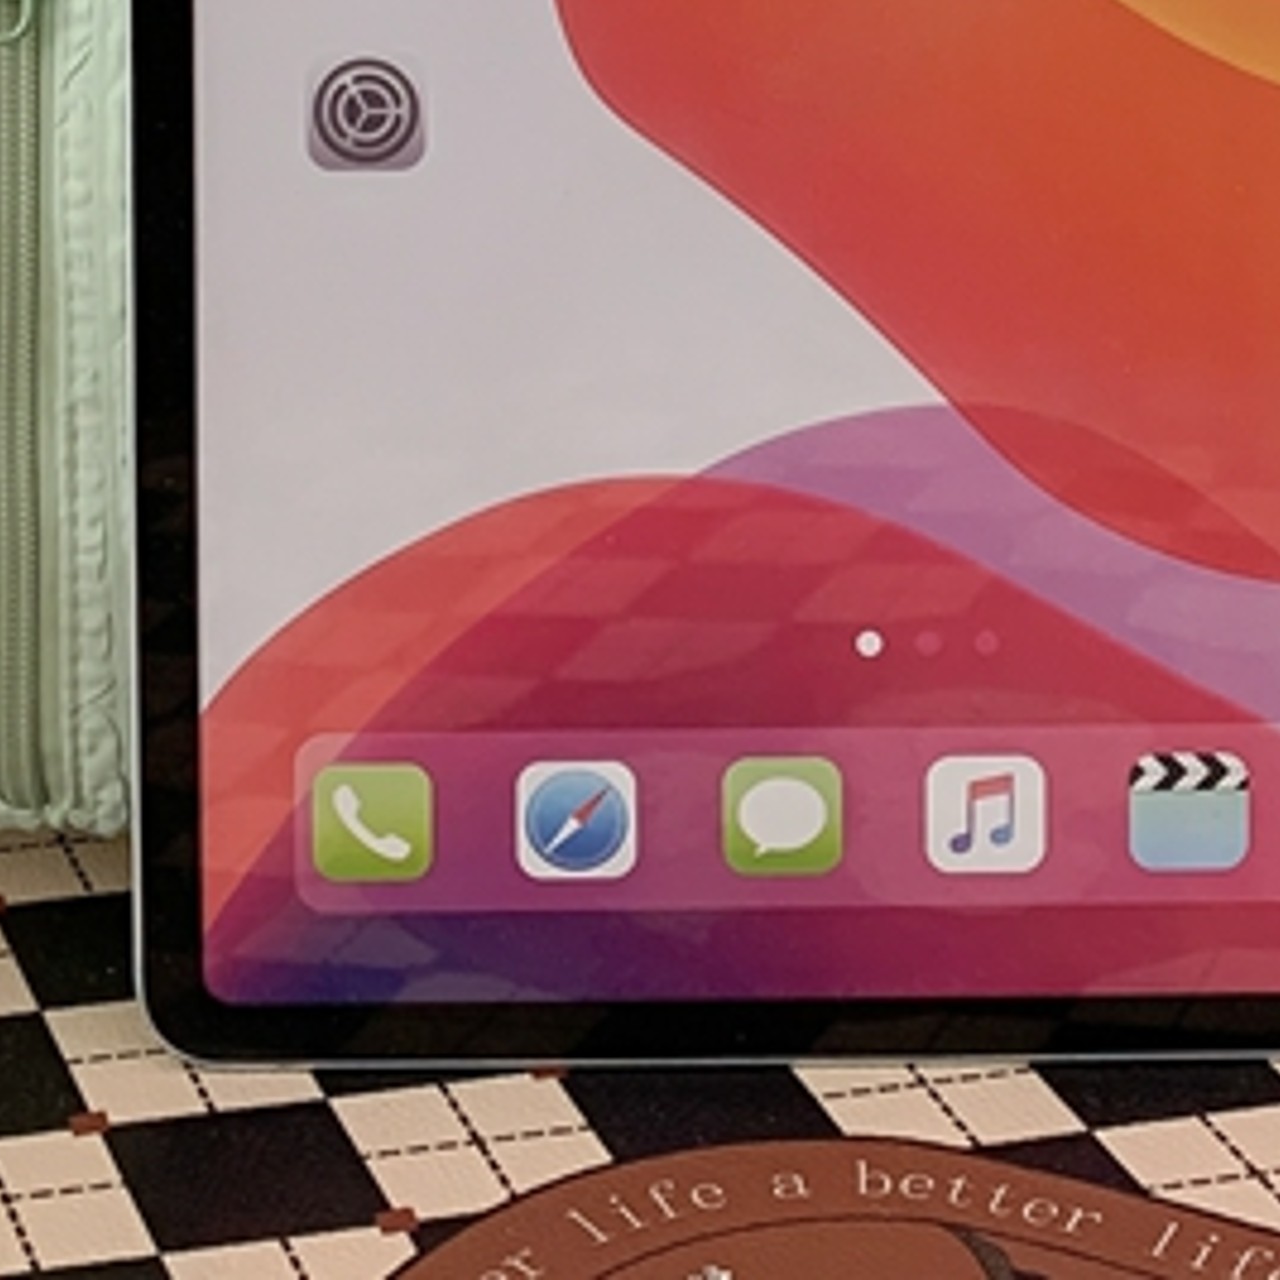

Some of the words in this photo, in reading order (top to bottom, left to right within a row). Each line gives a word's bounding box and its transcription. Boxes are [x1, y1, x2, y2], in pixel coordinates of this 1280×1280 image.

[565, 1180, 726, 1244] life
[772, 1171, 811, 1199] a
[855, 1158, 1104, 1236] better
